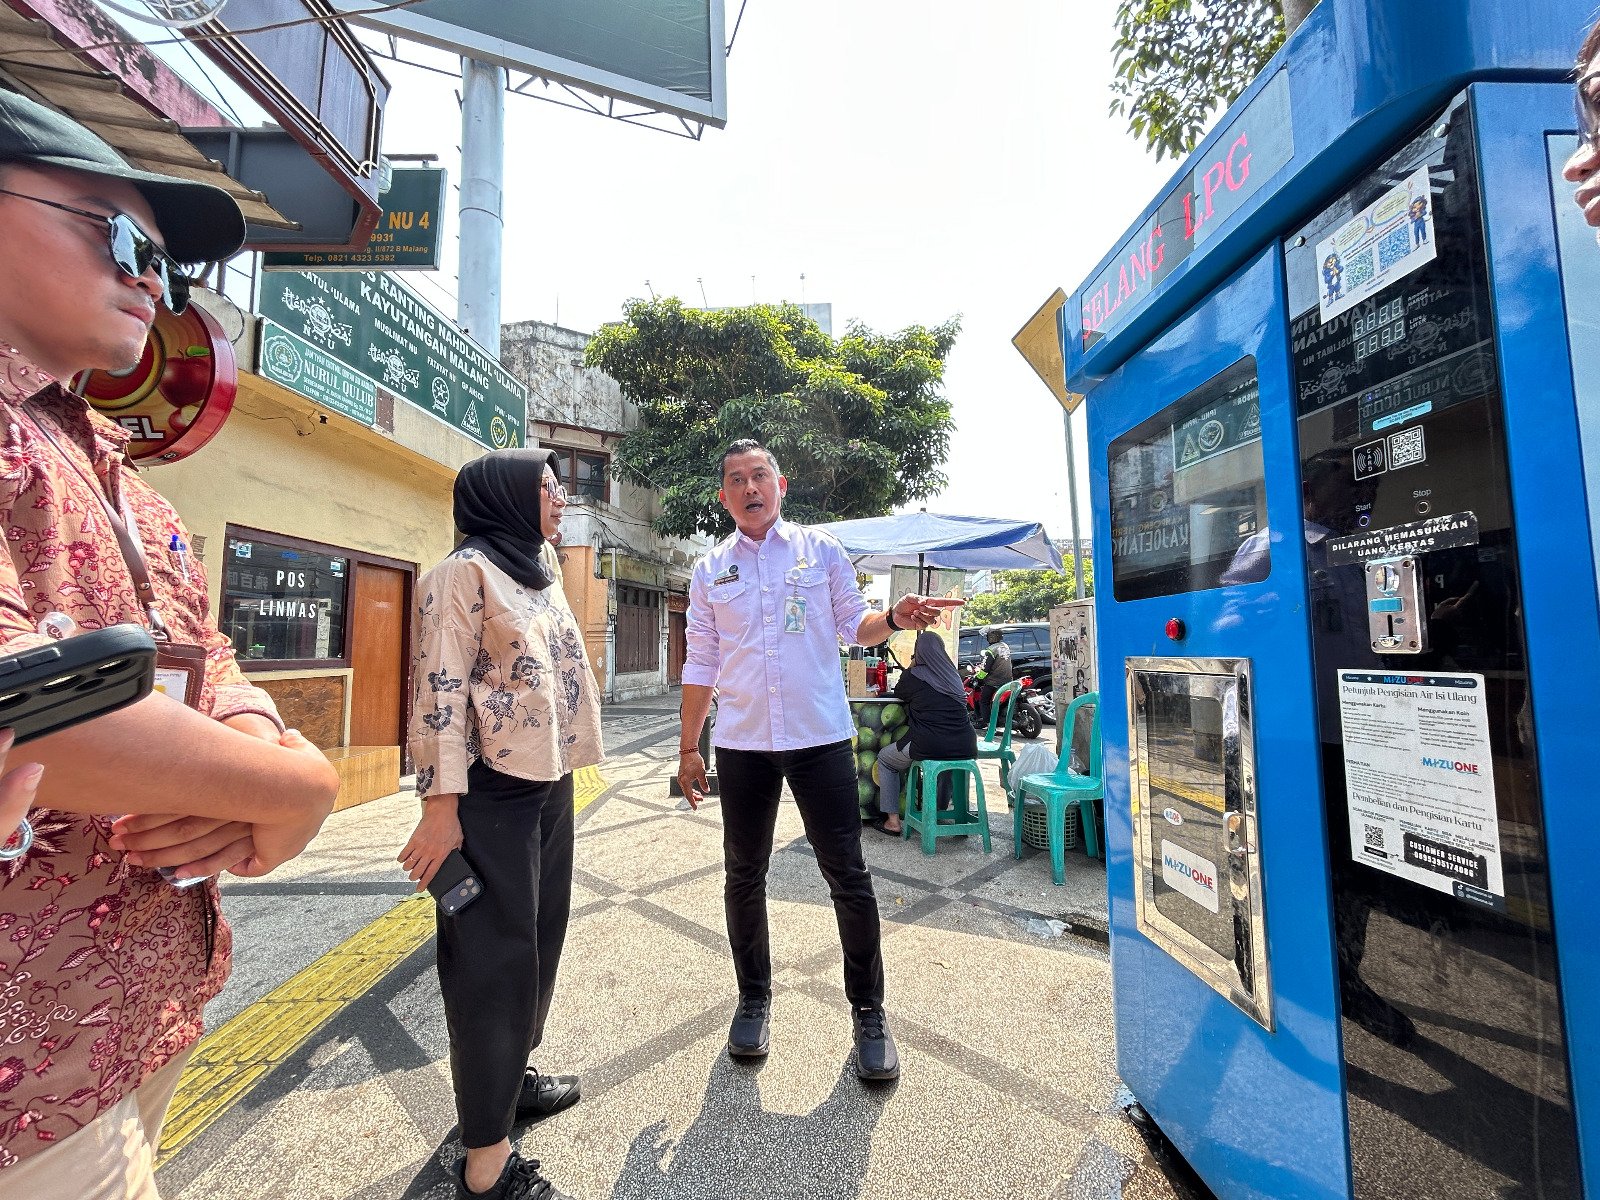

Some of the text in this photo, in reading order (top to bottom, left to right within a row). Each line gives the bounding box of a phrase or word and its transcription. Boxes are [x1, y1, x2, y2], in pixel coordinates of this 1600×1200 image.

[388, 211, 414, 230] NU
[418, 211, 430, 230] 4
[370, 233, 394, 242] 9931
[1082, 131, 1252, 340] SELANG LPG
[303, 254, 396, 263] Telp. 0821 4323 5382
[402, 245, 429, 254] Malang
[298, 271, 330, 294] LATUL
[360, 280, 447, 360] KAYUTANGAN
[449, 350, 490, 390] MALANG
[380, 274, 435, 330] RANTING
[438, 322, 493, 377] NAHDLATUL
[374, 317, 408, 348] MUSLIMAT
[408, 341, 418, 356] NU
[303, 359, 341, 391] NURUL
[342, 380, 375, 408] QULUB
[112, 416, 164, 440] EL
[1366, 448, 1374, 472] CARD
[1412, 488, 1432, 499] Stop
[1355, 502, 1372, 513] Start
[1331, 519, 1469, 552] DILARANG MEMASUKKAN
[1357, 537, 1436, 557] UANG KERTAS
[276, 569, 306, 588] POS
[259, 599, 317, 619] LINMAS
[1342, 685, 1478, 705] Petunjuk Pengisian Air Isi Ulang
[1417, 706, 1456, 715] Menggunakan
[1352, 791, 1483, 831] Pembelian dan Pengisian Kartu
[1409, 840, 1479, 870] CUSTOMER SERVICE
